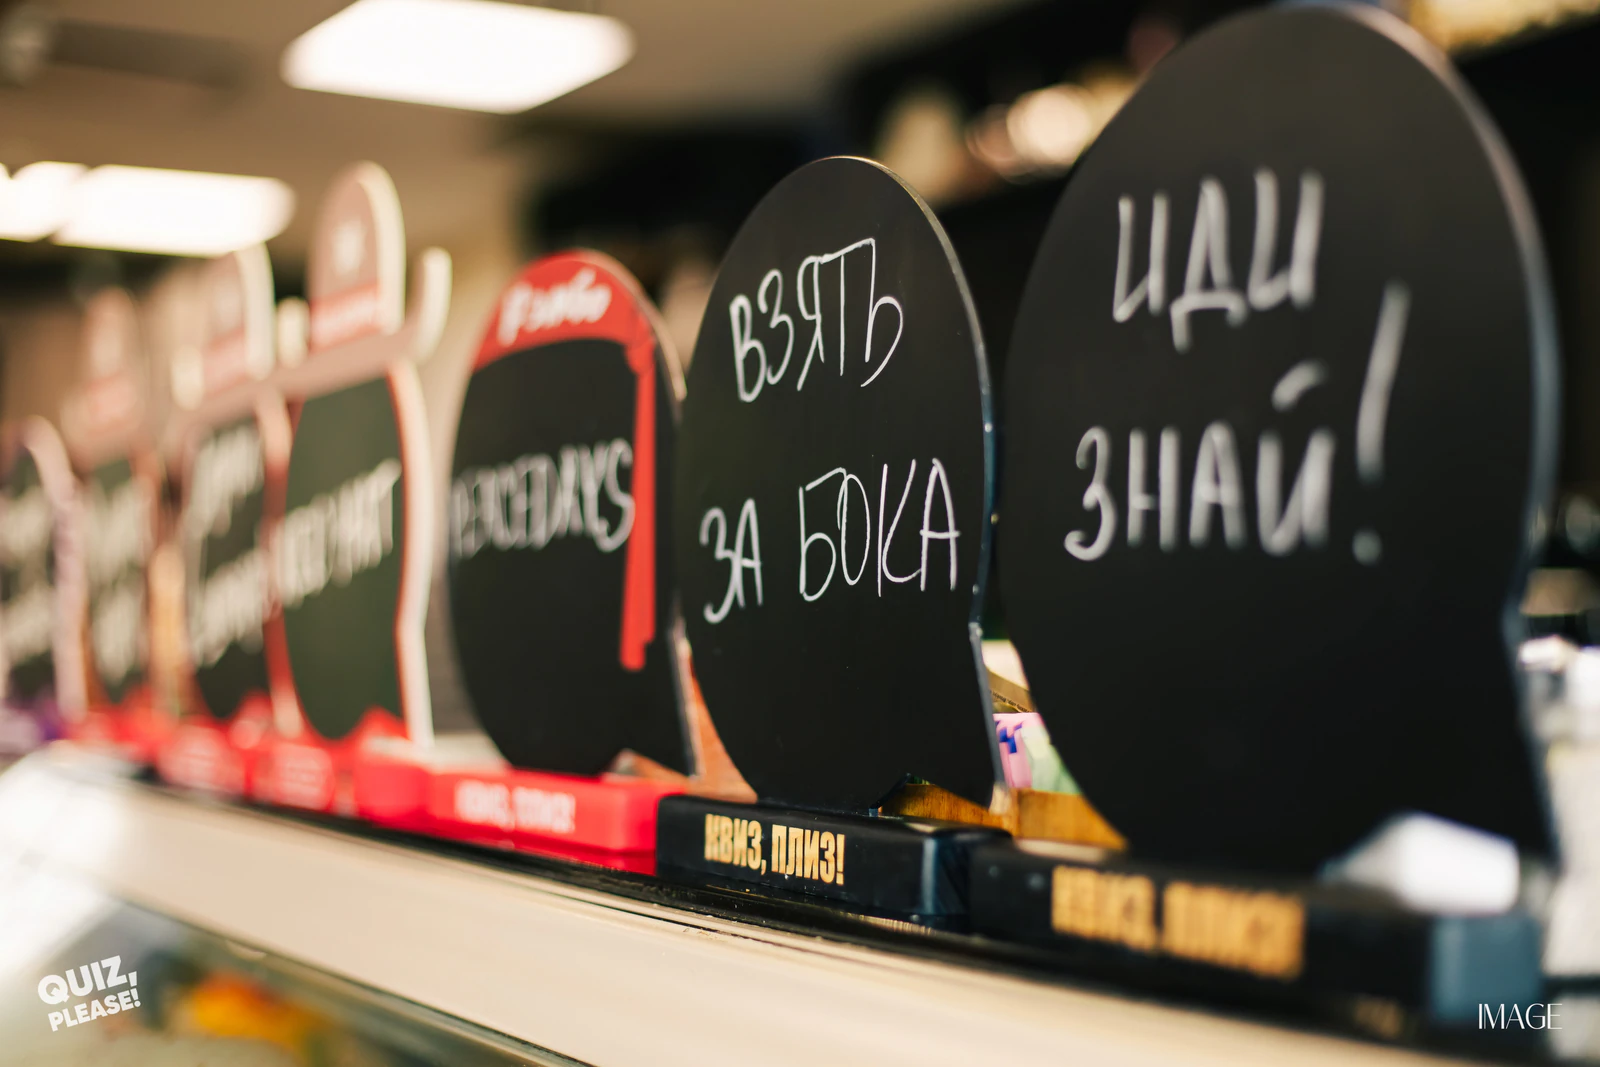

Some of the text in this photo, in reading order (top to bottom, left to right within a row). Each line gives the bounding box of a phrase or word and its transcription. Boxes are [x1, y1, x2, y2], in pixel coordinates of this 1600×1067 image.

[730, 238, 903, 402] ВЗЯТЬ
[1113, 166, 1325, 353] ИДИ
[1064, 280, 1411, 565] ЗНАЙ!
[700, 458, 960, 623] ЗА БОКА
[703, 813, 846, 885] КВИЗ, ПЛИЗ!
